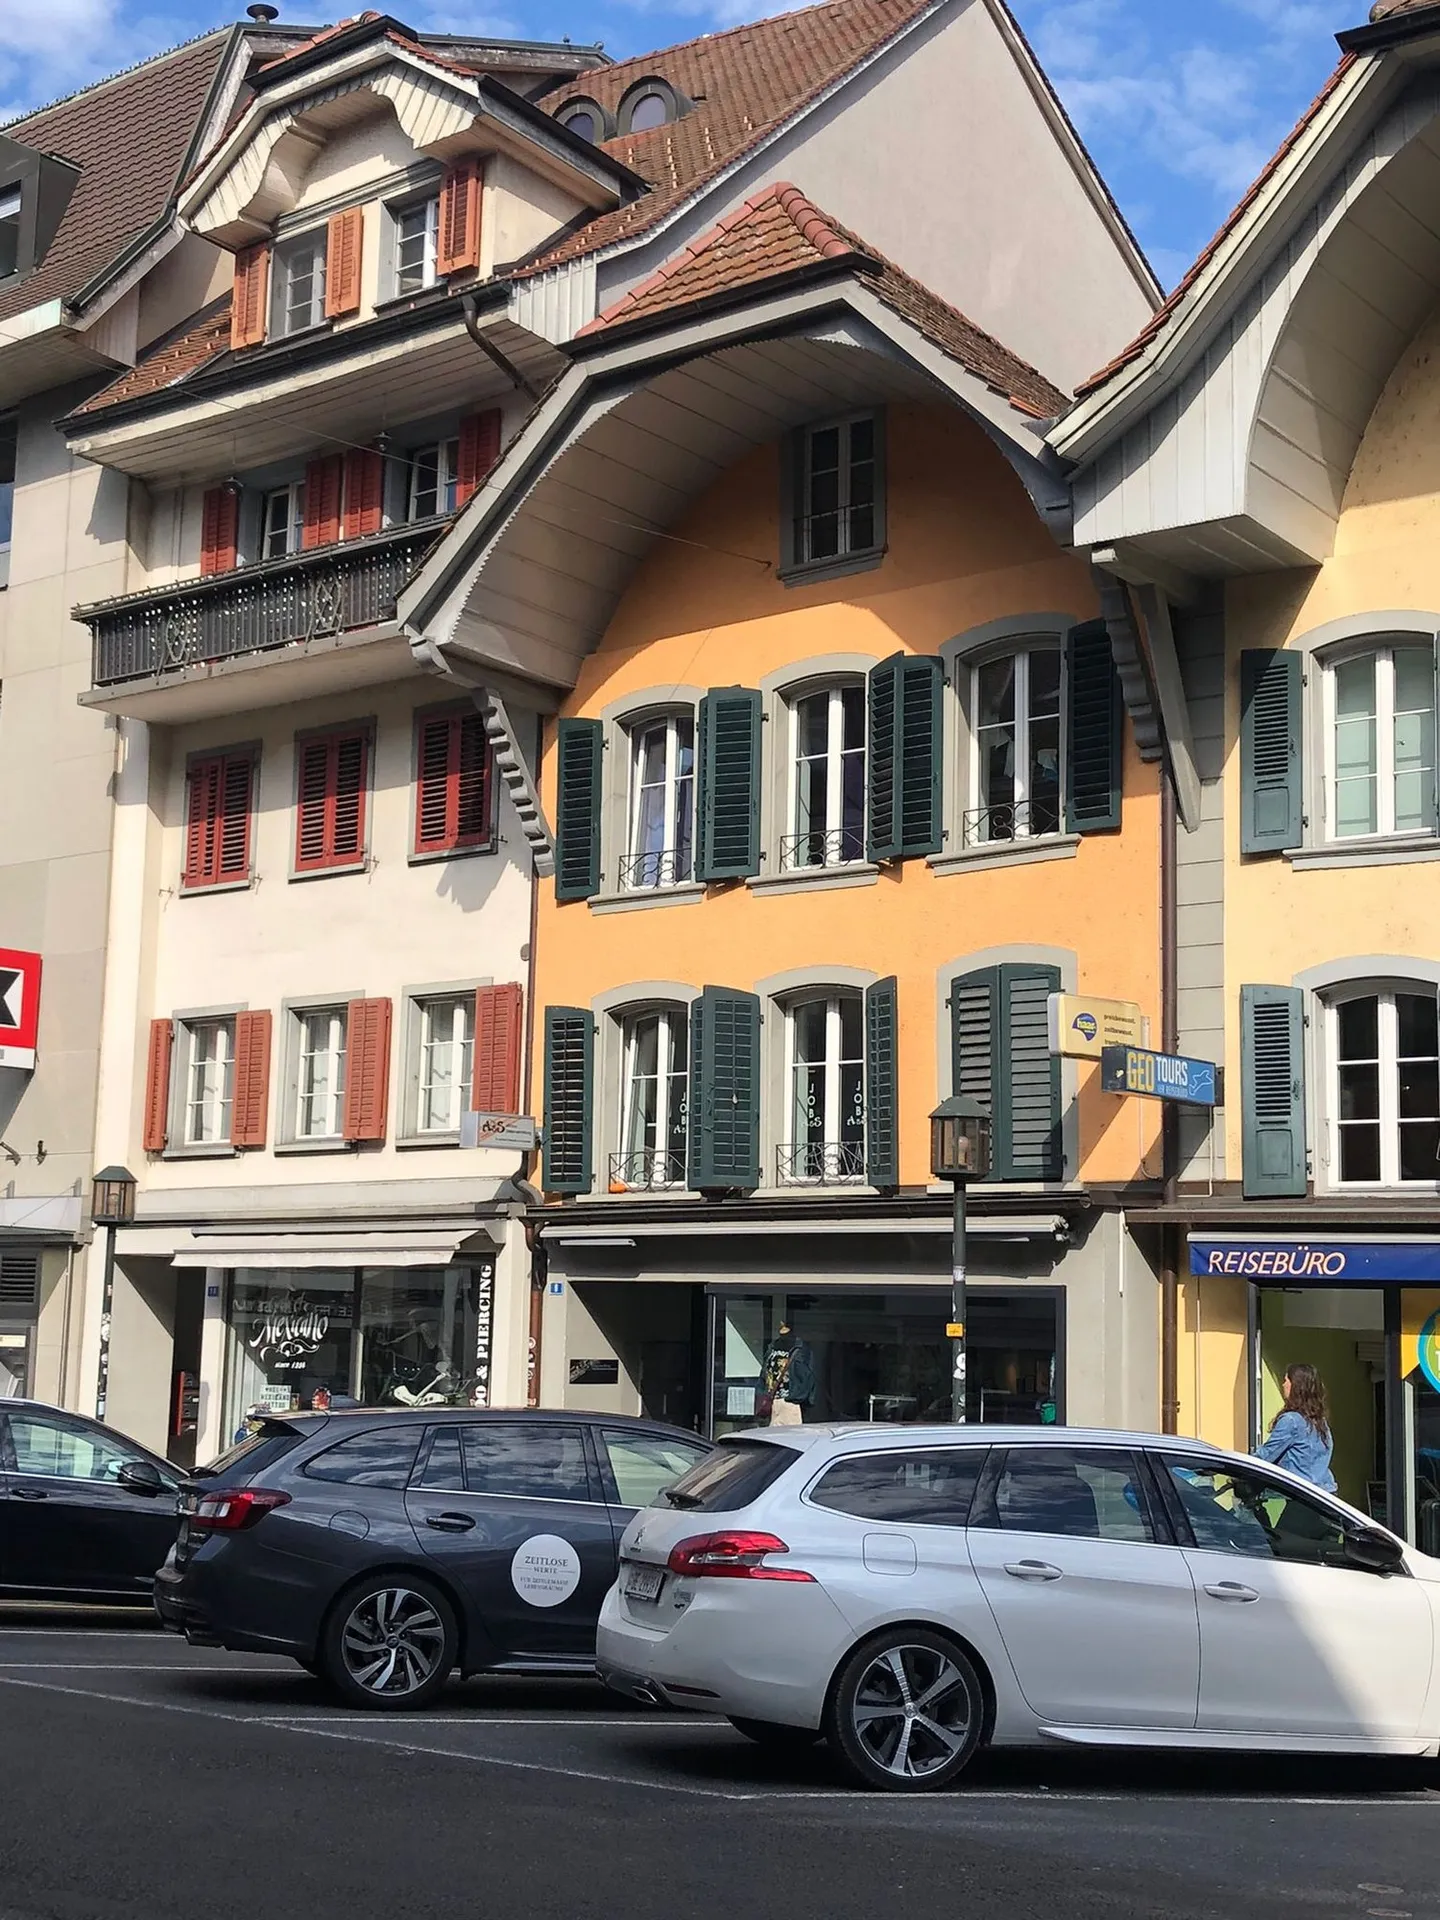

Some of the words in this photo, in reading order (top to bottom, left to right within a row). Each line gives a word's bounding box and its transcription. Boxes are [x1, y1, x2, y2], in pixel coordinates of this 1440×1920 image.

[1127, 1051, 1155, 1092] GEO
[1156, 1056, 1188, 1086] TOURS
[1208, 1245, 1346, 1275] REISEBÜRO
[476, 1264, 492, 1359] PIERCING
[476, 1364, 488, 1380] &
[524, 1555, 569, 1567] ZEITLOSE
